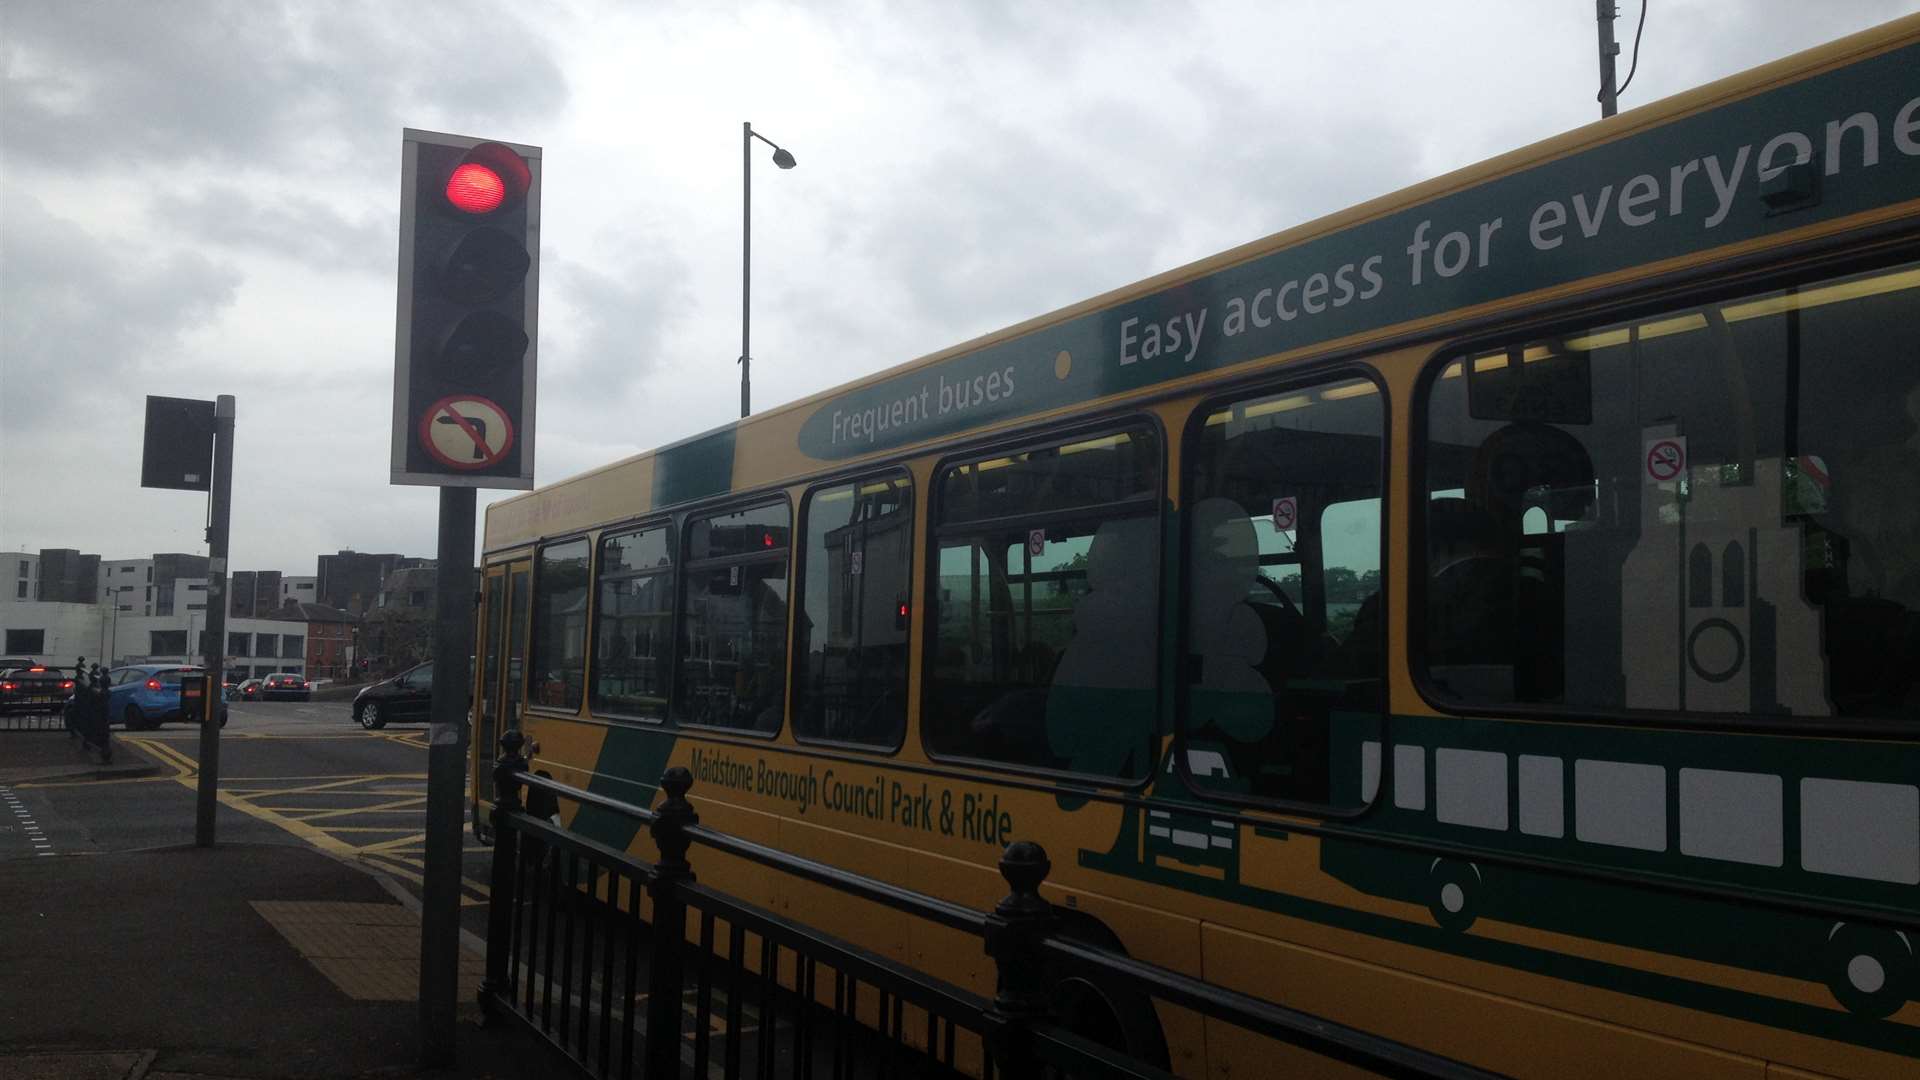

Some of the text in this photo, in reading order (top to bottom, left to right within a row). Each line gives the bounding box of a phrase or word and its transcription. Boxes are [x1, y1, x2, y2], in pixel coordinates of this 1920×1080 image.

[1119, 309, 1207, 366] Easy
[1223, 255, 1383, 336] access
[1407, 220, 1502, 286] for
[831, 366, 1015, 444] Frequent buses
[692, 748, 1012, 849] Maidstone Borough Council Park & Ride
